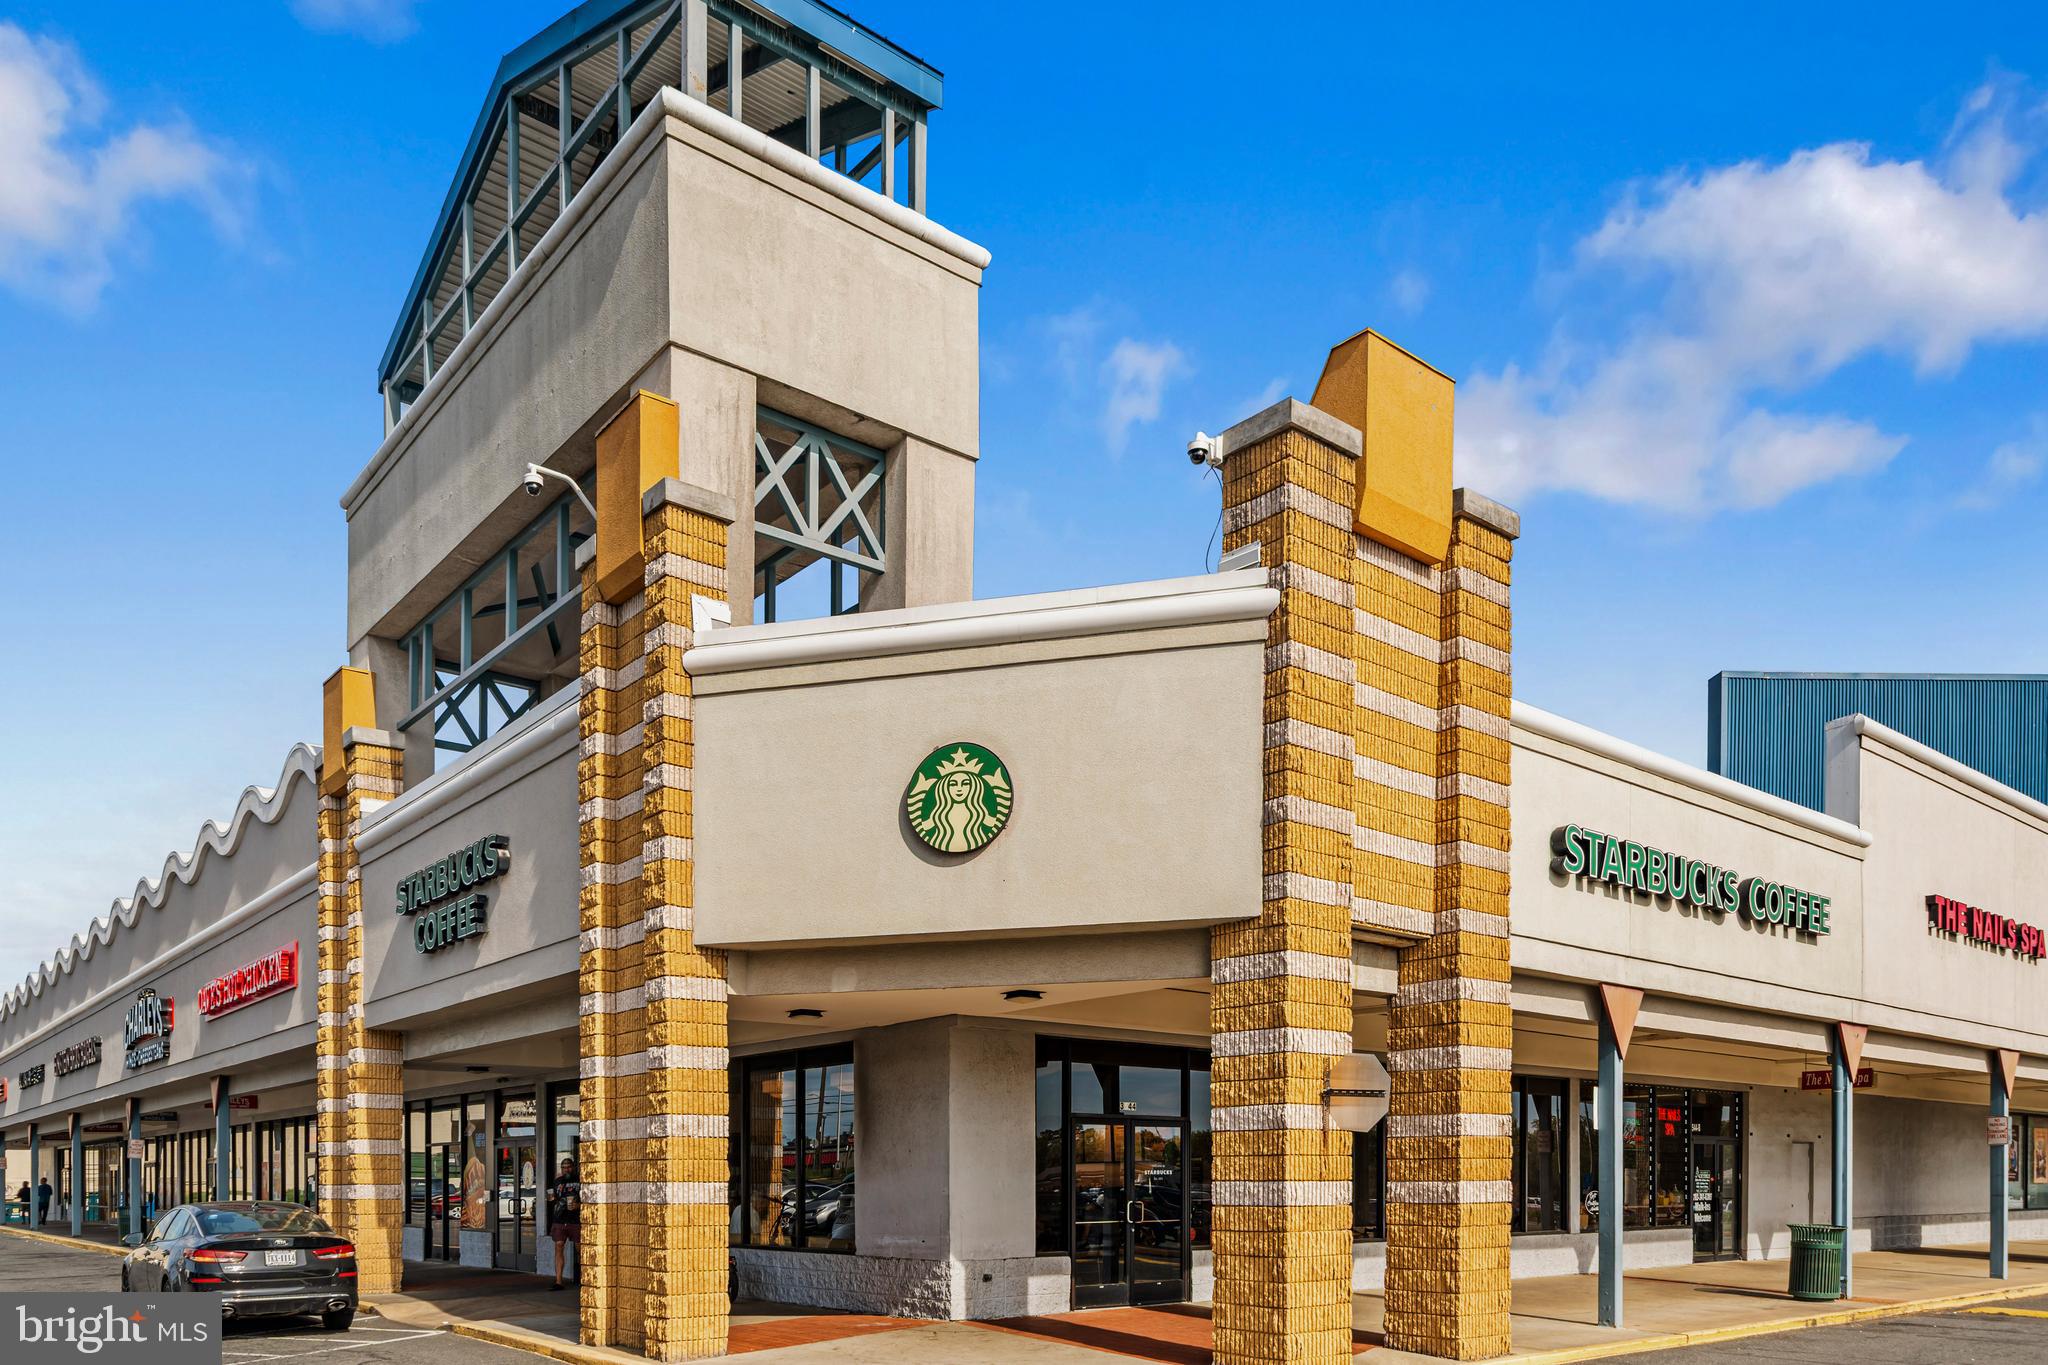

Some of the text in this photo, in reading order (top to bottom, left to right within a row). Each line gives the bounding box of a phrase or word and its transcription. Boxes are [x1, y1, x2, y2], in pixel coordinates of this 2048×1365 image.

[396, 833, 504, 916] STARBUCKS
[1558, 823, 1832, 936] STARBUCKS COFFEE
[414, 893, 482, 954] COFFEE
[1930, 894, 2047, 959] THE NAILS SPA
[123, 997, 163, 1050] CHARLEYS
[1806, 1072, 1822, 1086] The
